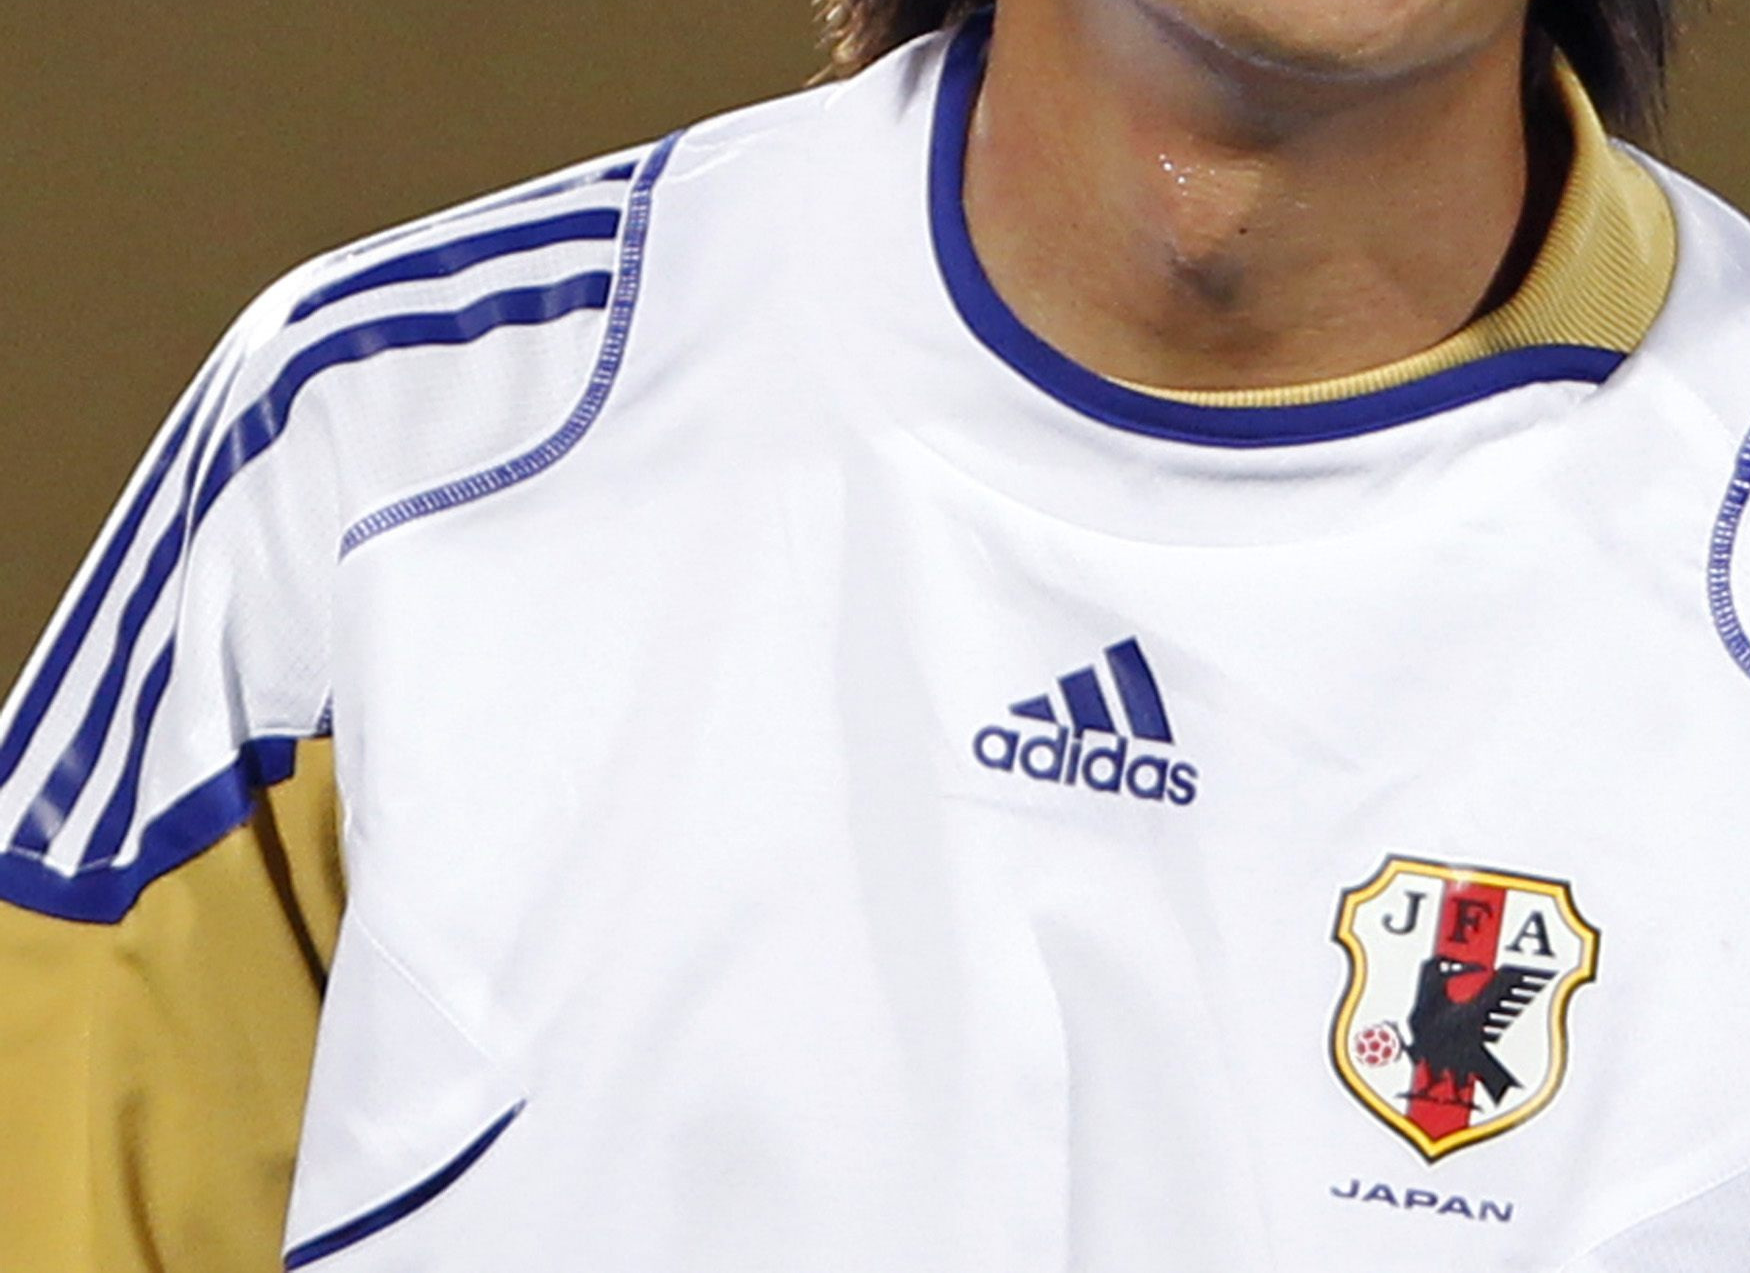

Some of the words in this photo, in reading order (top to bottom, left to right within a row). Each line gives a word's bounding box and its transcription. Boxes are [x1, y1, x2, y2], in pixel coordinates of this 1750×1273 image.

[973, 725, 1199, 806] adidas
[1382, 890, 1557, 958] JFA
[1330, 1178, 1514, 1223] JAPAN
